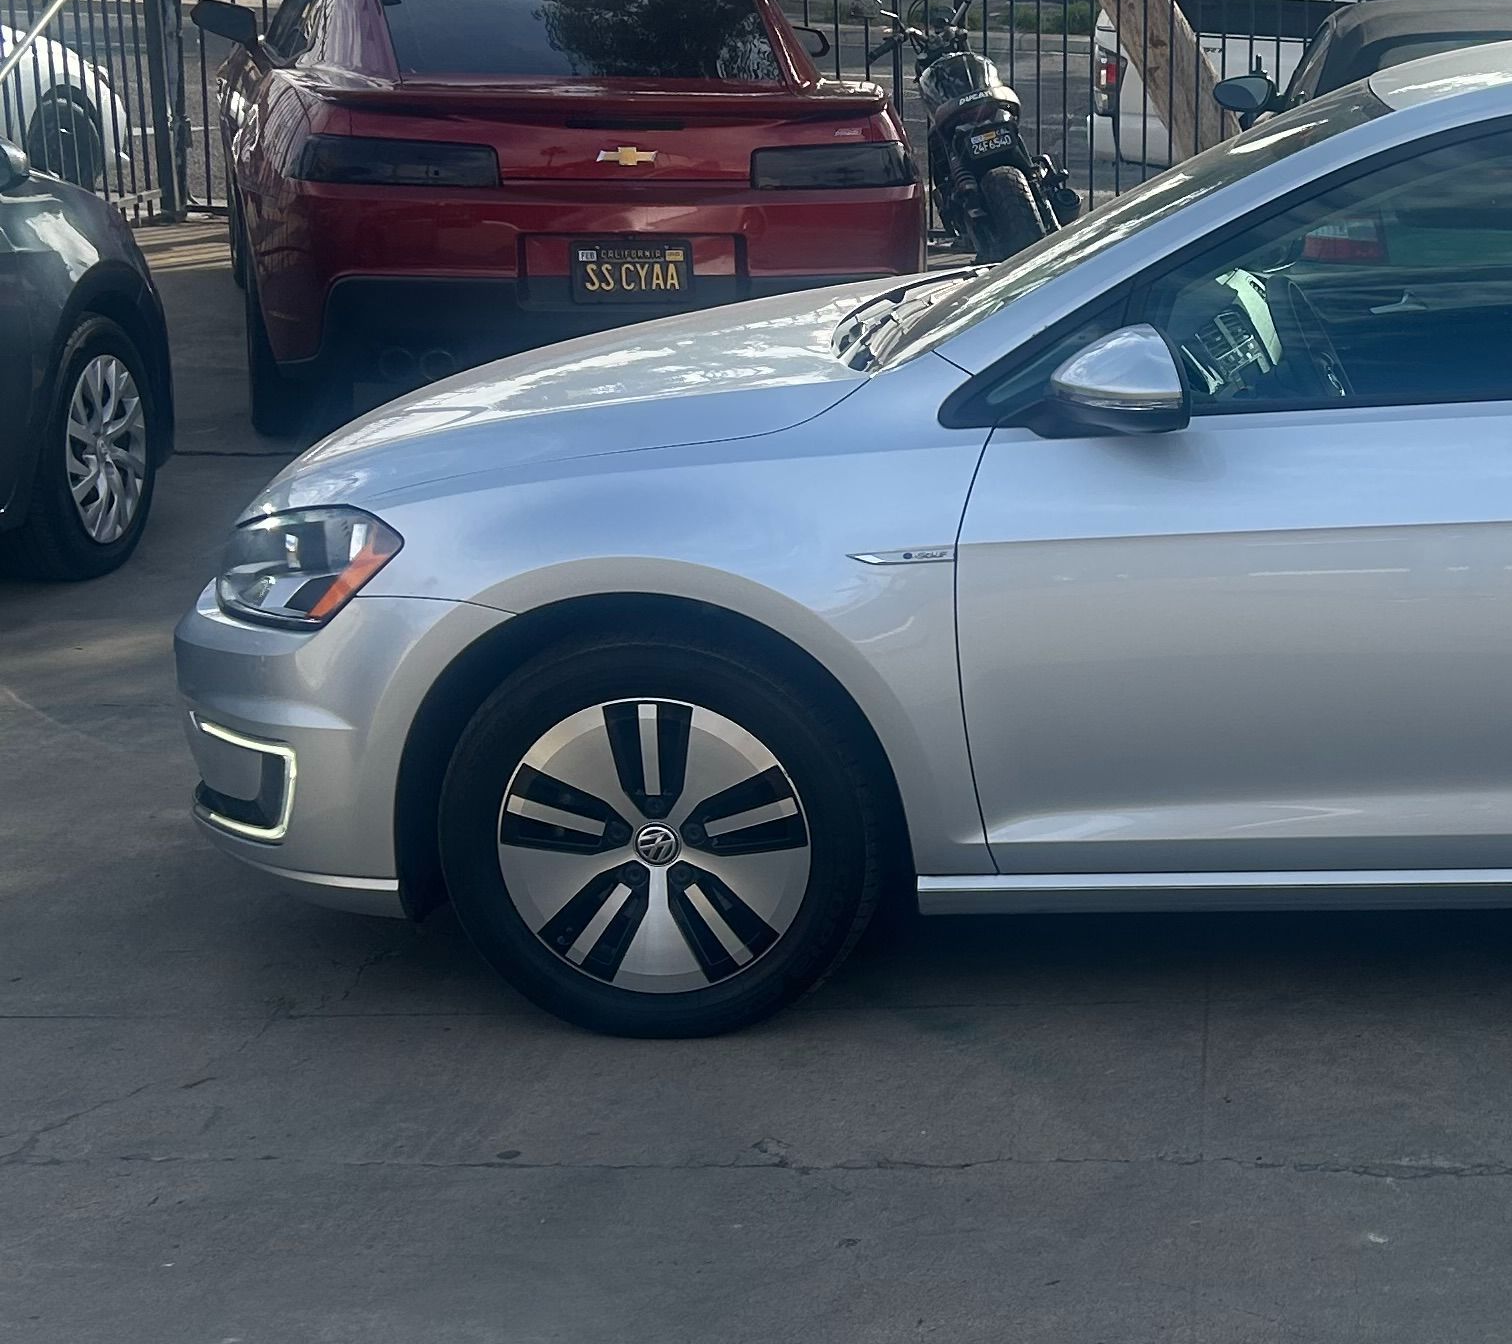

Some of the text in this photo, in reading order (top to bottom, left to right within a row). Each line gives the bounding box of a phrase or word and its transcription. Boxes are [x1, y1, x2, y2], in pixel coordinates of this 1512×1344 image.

[601, 250, 661, 258] CALIFORNIA
[585, 263, 680, 291] SS CYAA
